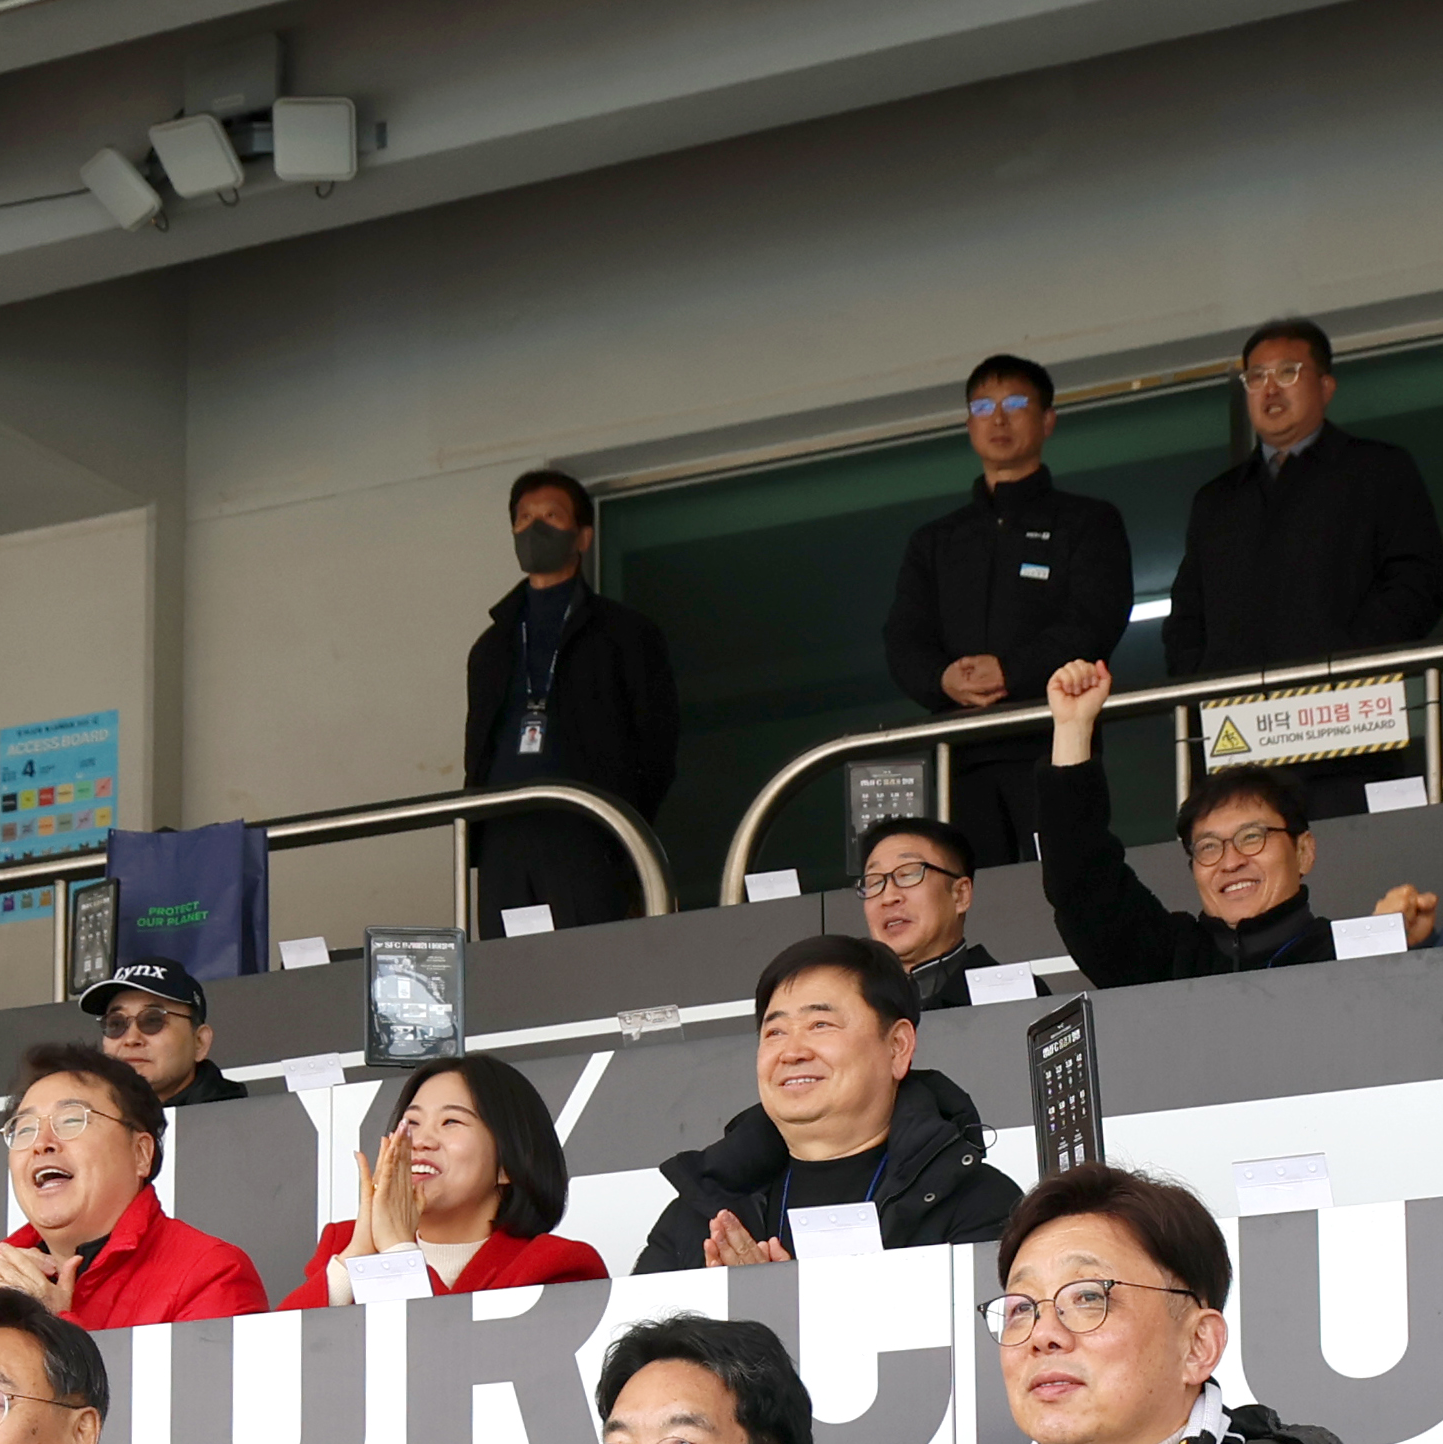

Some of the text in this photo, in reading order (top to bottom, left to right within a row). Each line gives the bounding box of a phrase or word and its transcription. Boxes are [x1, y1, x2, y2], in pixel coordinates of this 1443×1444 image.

[1257, 697, 1393, 733] 바닥 미끄럼 주의
[61, 729, 109, 747] BOARD
[1259, 718, 1396, 747] CAUTION SLIPPING HAZARD
[21, 759, 36, 777] 4
[148, 901, 199, 916] PROTECT
[137, 911, 209, 927] OUR PLANET
[114, 964, 168, 980] Lynx
